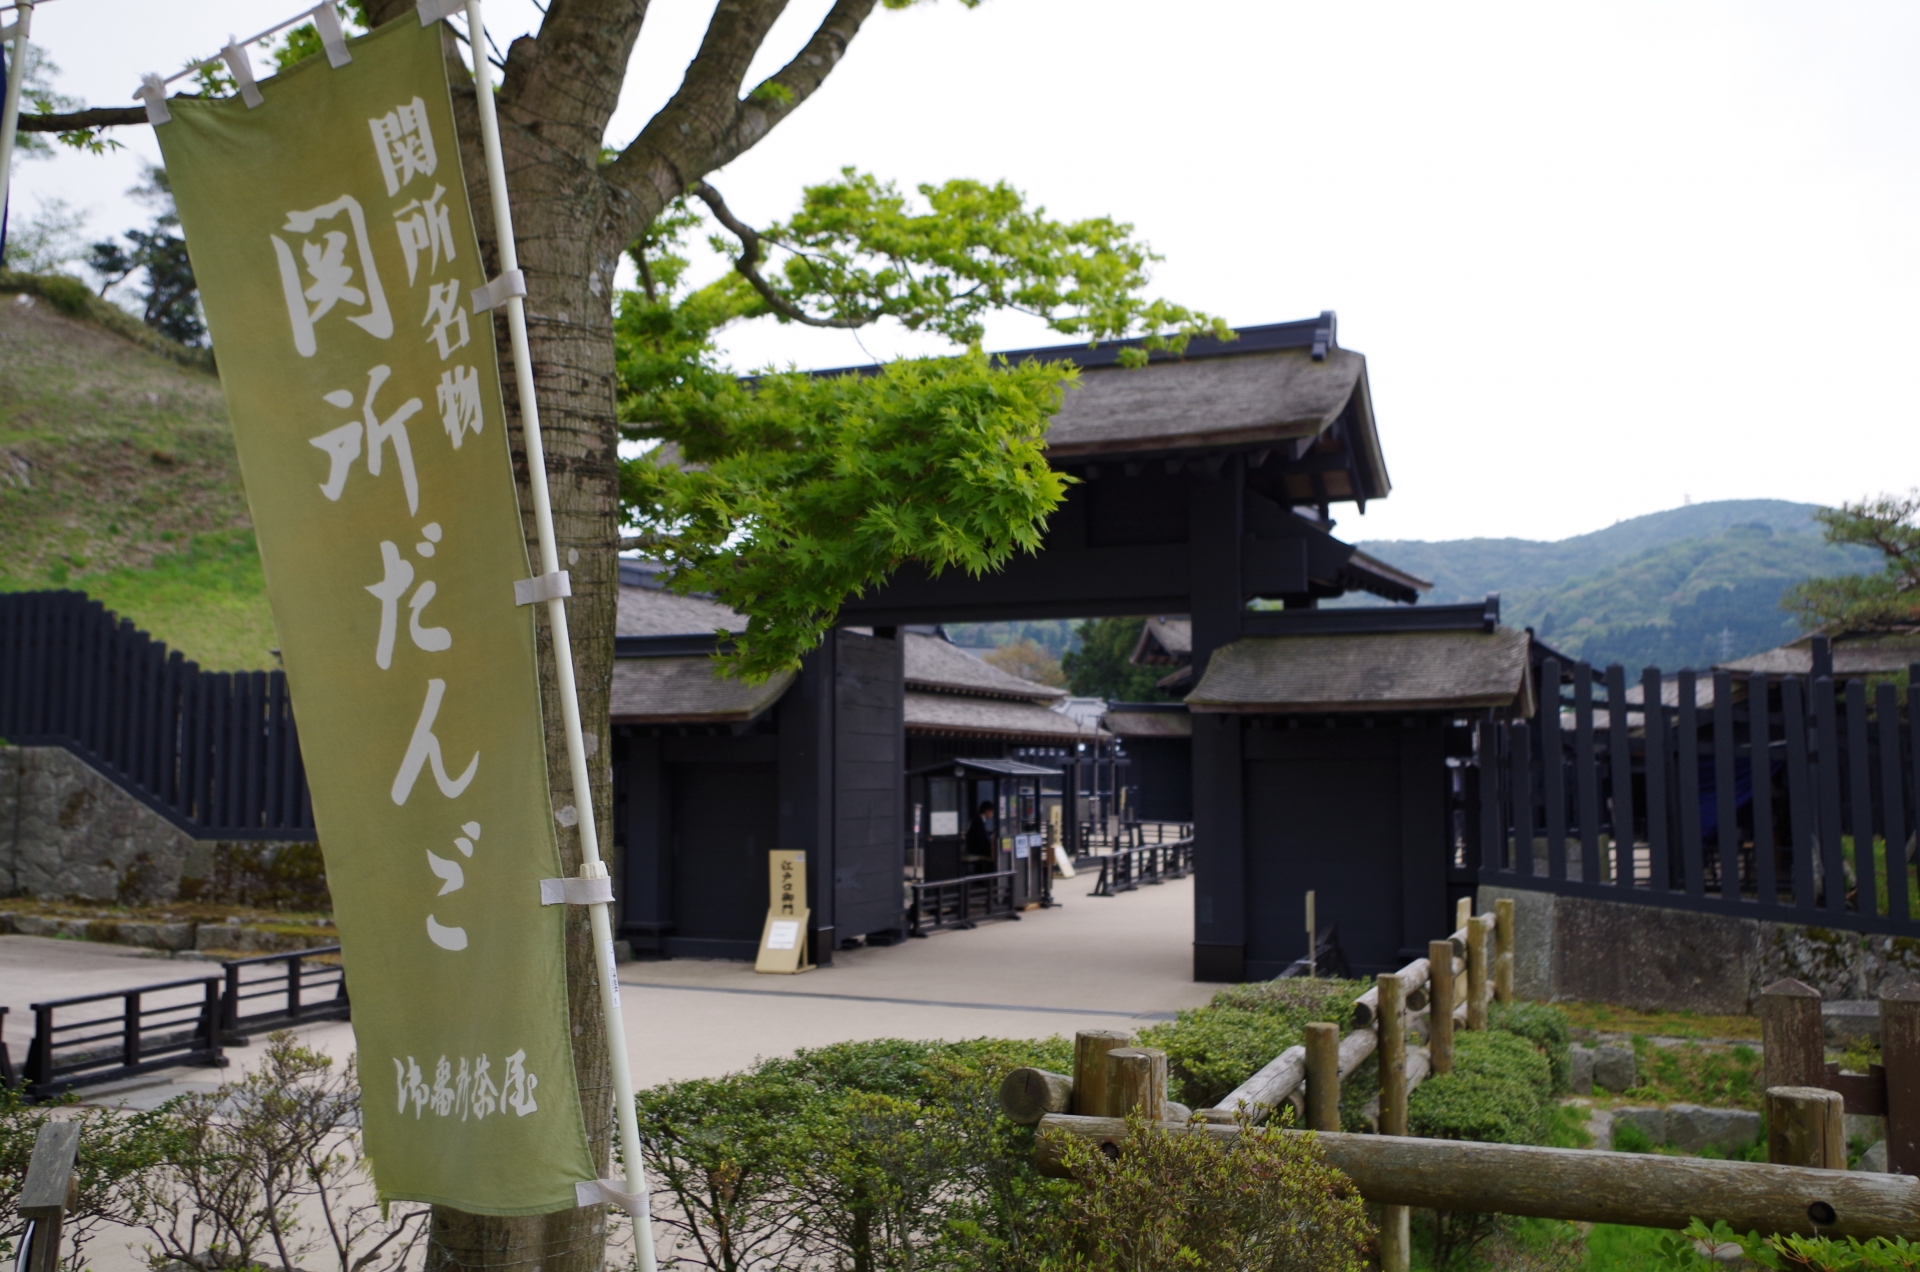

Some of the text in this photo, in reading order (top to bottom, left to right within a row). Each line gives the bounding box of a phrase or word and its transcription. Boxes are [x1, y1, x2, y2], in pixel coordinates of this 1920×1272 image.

[368, 95, 484, 449] 関所名物
[270, 194, 482, 952] 関所だんご
